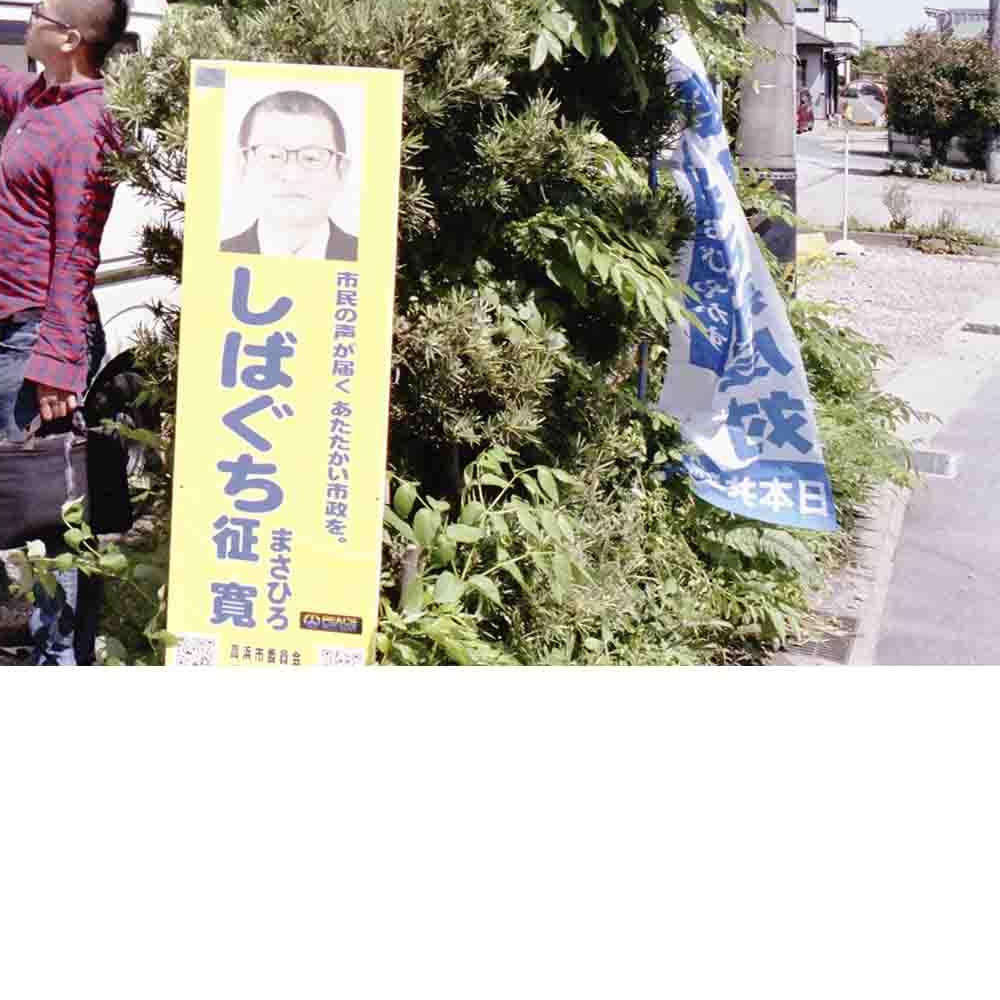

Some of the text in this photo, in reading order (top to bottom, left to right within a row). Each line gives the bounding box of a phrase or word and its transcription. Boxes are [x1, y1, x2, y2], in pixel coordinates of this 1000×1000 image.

[215, 265, 299, 515] しばぐち
[323, 270, 360, 545] 市民の声が届く あたたかい市政を。
[265, 527, 294, 633] まさひろ
